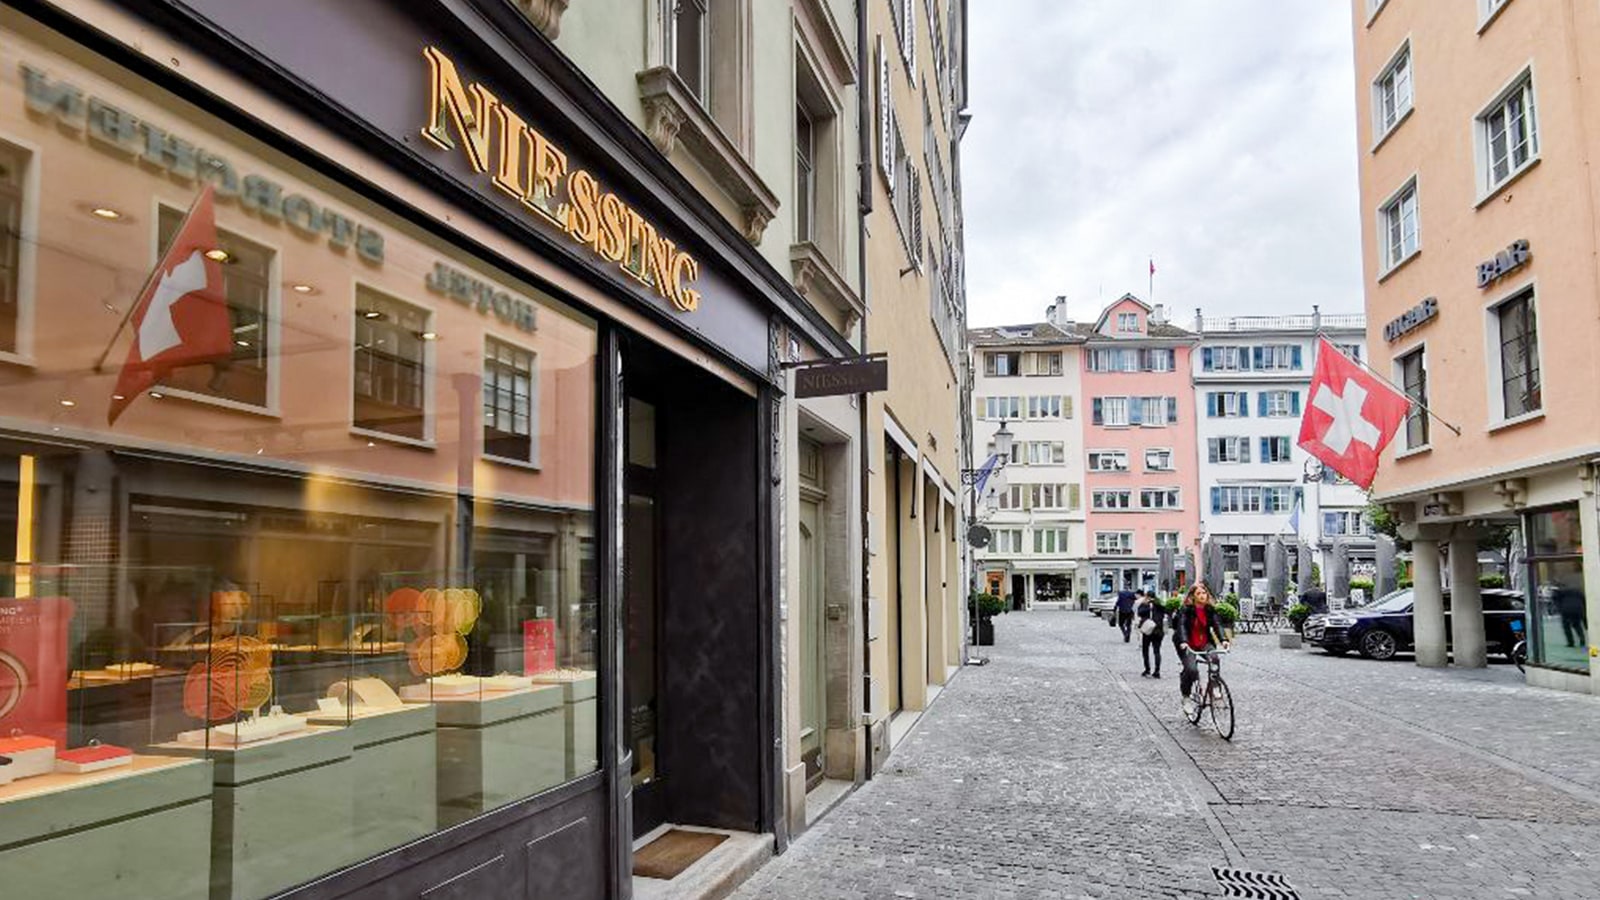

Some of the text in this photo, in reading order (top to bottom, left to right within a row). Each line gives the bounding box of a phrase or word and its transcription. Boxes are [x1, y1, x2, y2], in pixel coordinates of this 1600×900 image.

[421, 45, 701, 312] NIESSING
[1476, 239, 1530, 288] BAR
[802, 372, 878, 391] NIESSI
